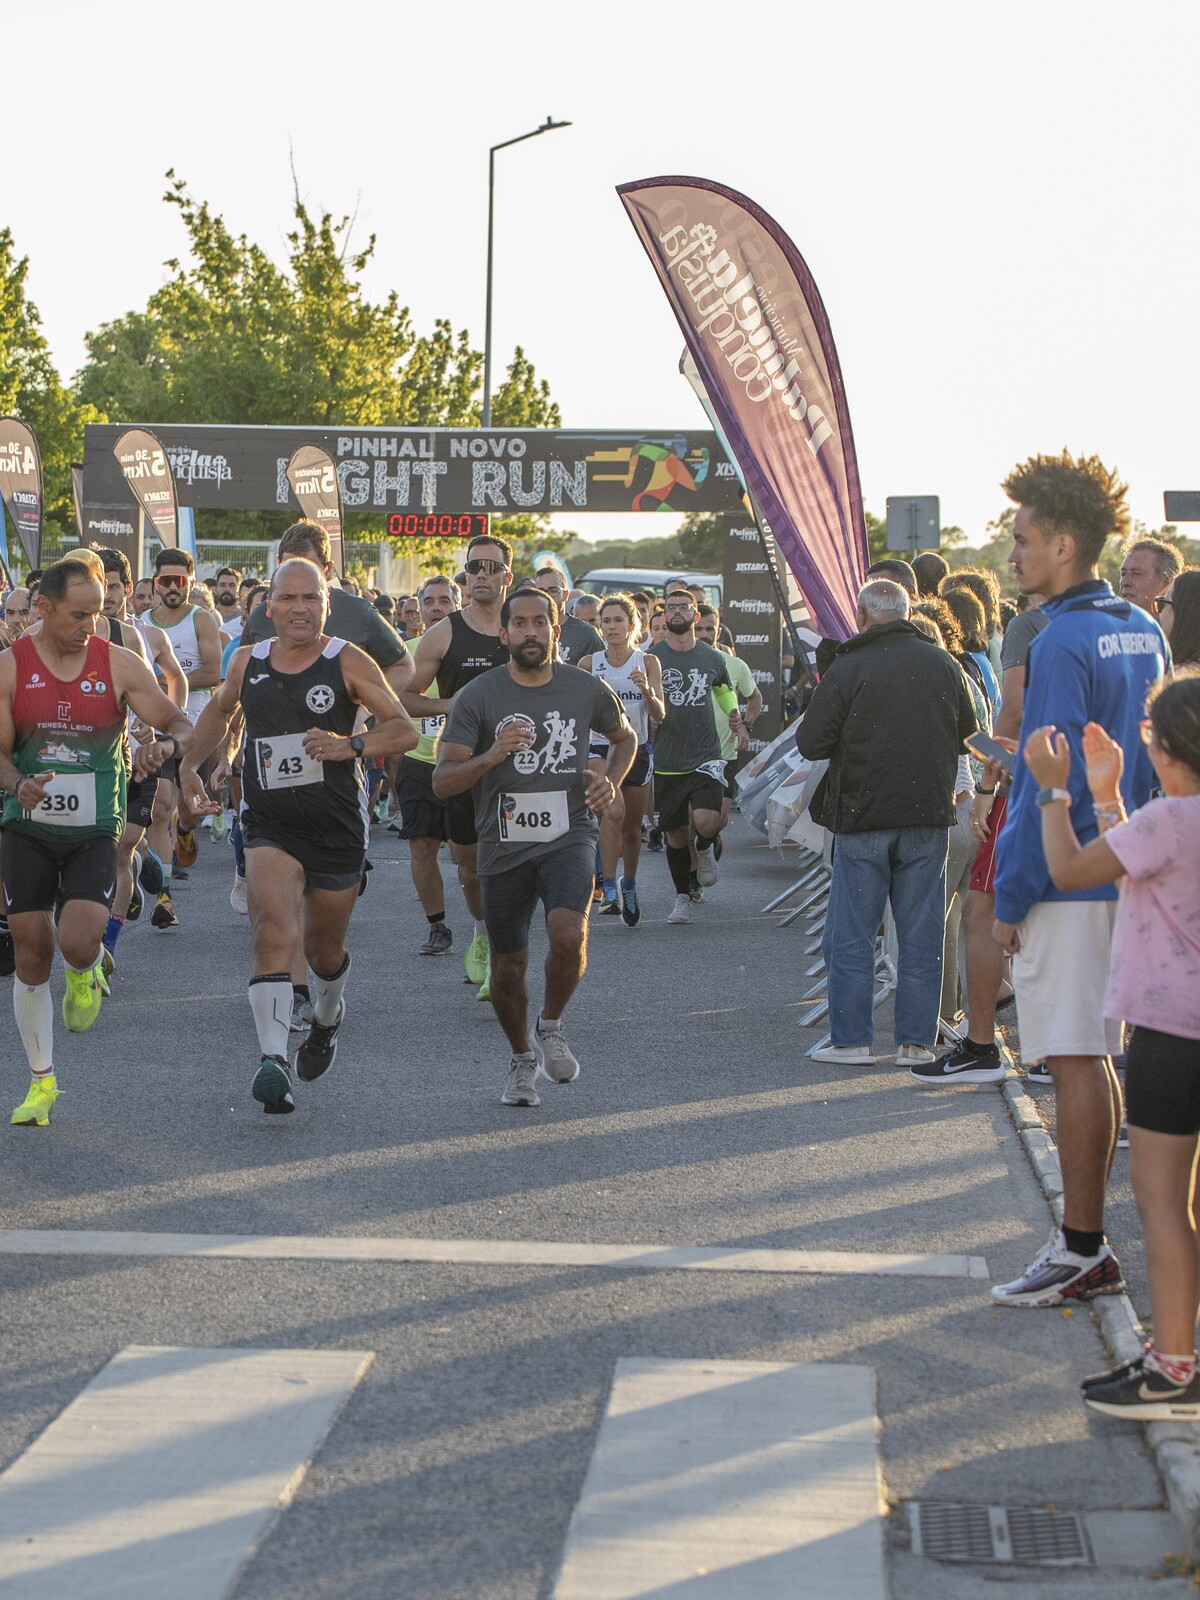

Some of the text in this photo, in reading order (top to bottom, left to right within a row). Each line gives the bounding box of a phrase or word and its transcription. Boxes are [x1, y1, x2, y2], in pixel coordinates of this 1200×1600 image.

[337, 436, 527, 458] PINHAL NOVO
[471, 459, 588, 507] RUN
[389, 514, 487, 536] 00:00:07
[735, 563, 769, 571] XISTARCA
[735, 635, 769, 643] XISTARCA
[26, 682, 46, 690] VIATOR
[37, 722, 67, 730] TERESA
[278, 757, 303, 775] 43
[518, 753, 535, 764] 22
[41, 794, 79, 812] 330
[515, 812, 552, 828] 408
